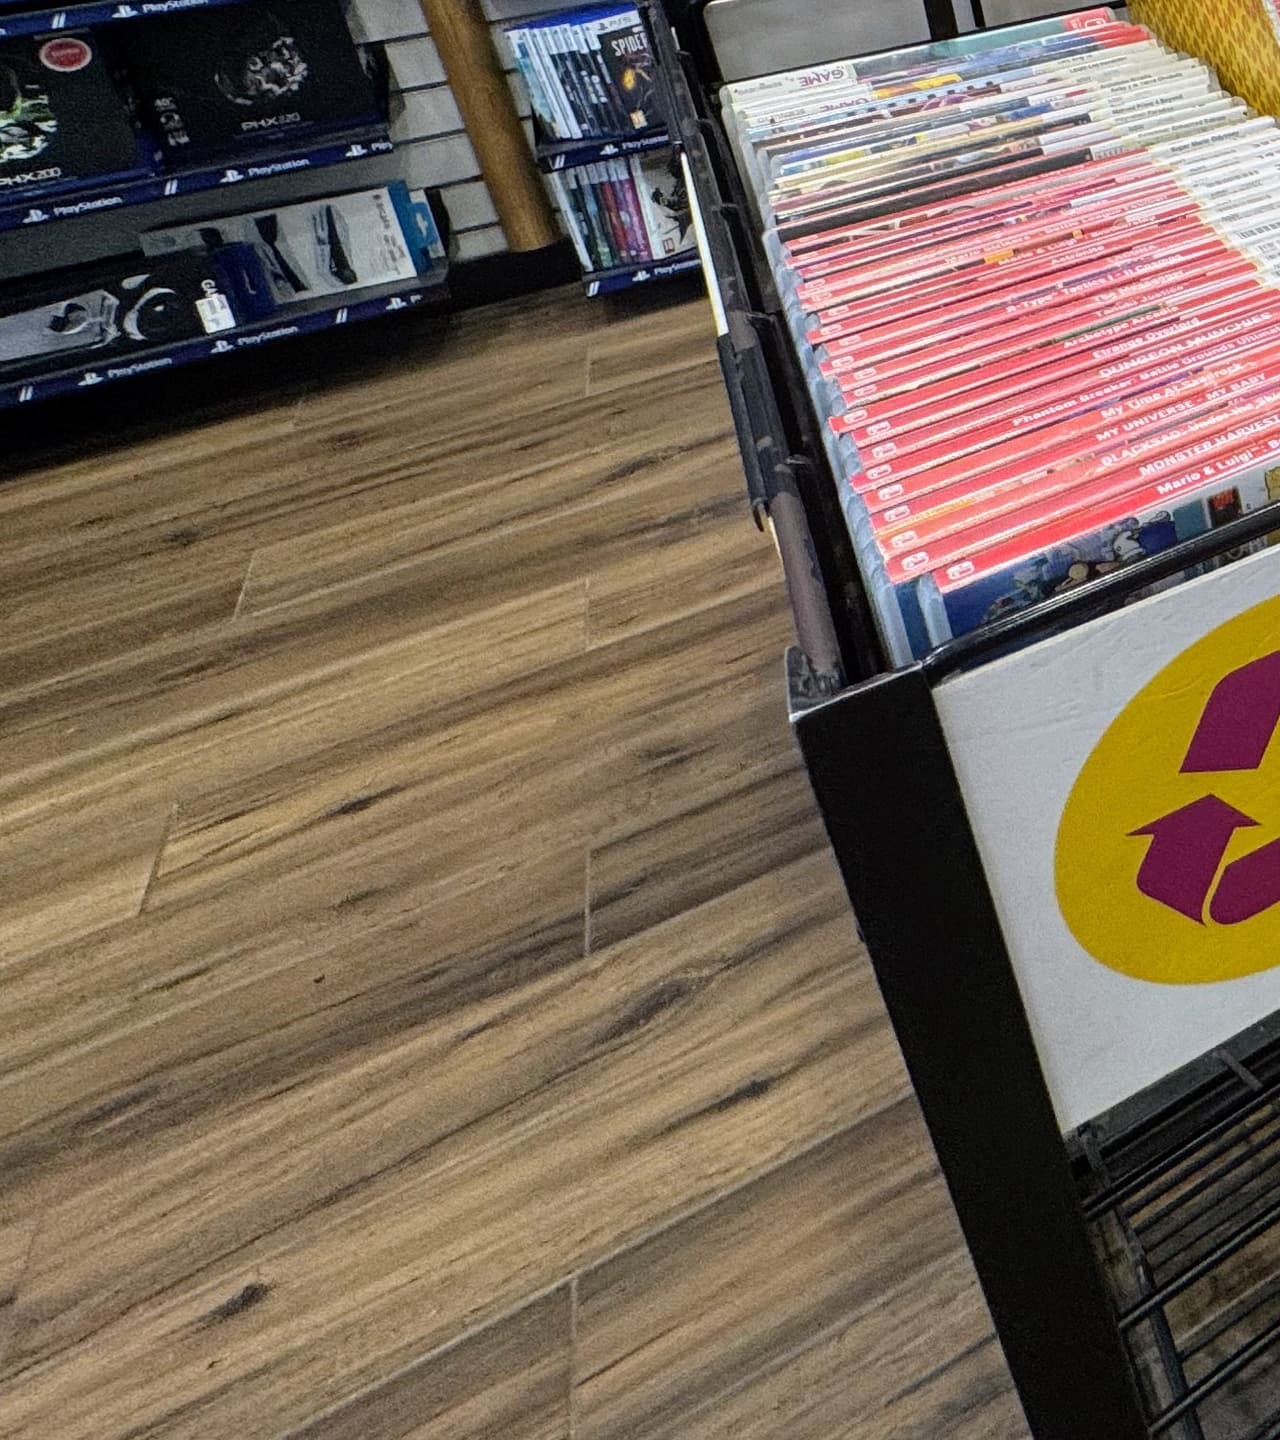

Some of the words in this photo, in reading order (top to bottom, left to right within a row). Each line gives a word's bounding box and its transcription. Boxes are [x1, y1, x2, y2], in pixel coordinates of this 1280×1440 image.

[249, 157, 310, 177] PlayStation
[55, 195, 122, 217] PlayStation
[108, 357, 172, 379] PlayStation
[1139, 437, 1215, 478] MONSTER
[1156, 471, 1201, 495] Mario
